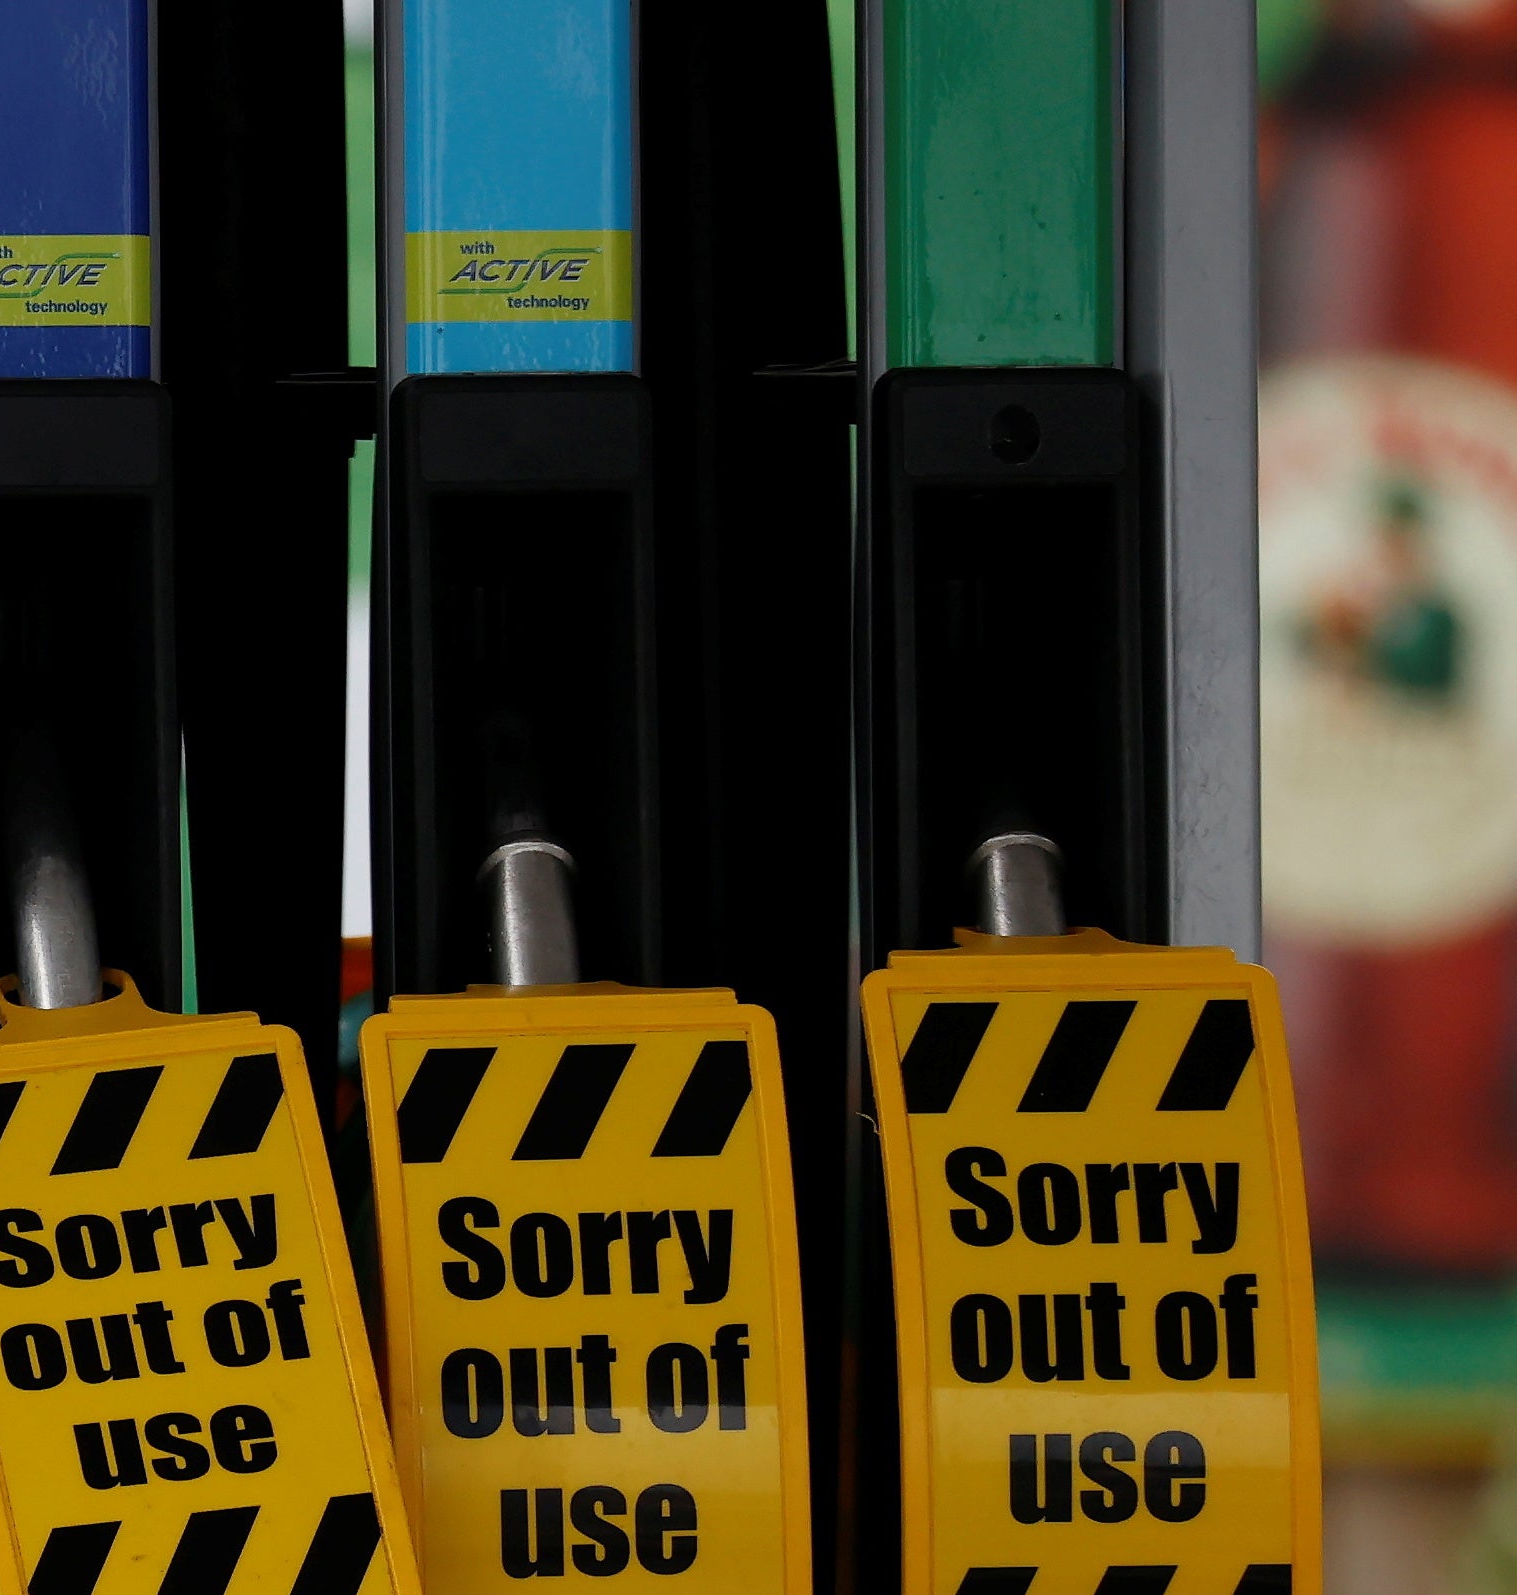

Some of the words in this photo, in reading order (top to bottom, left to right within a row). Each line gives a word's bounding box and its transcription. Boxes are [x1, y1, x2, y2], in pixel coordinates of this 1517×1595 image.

[450, 258, 589, 282] ACTIVE
[460, 241, 494, 255] with
[25, 300, 107, 315] technology
[507, 295, 589, 310] technology
[945, 1147, 1240, 1254] Sorry
[438, 1197, 733, 1304] Sorry
[0, 1301, 185, 1390] out
[204, 1279, 310, 1367] of
[950, 1283, 1130, 1383] out
[1155, 1274, 1258, 1381] of
[441, 1335, 620, 1439] out
[646, 1324, 750, 1432] of
[73, 1404, 278, 1490] use
[1010, 1429, 1206, 1524] use
[500, 1484, 697, 1579] use
